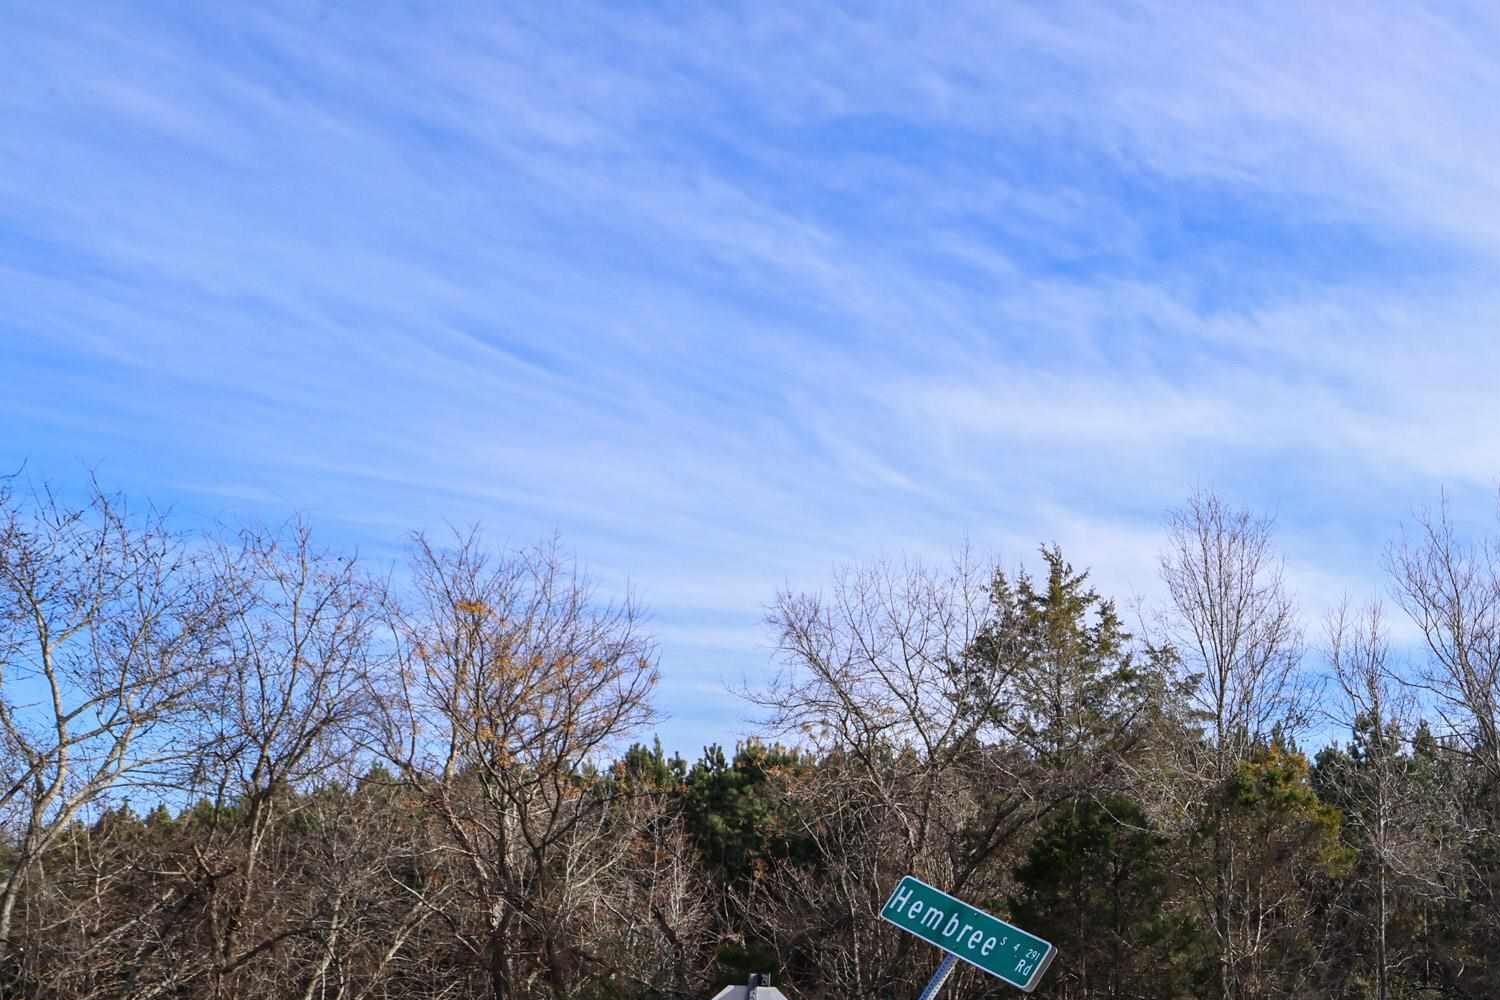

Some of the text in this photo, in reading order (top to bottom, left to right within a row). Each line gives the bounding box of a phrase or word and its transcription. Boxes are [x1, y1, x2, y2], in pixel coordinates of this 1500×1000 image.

[889, 885, 997, 956] Hembree
[1025, 948, 1040, 961] 291
[1014, 959, 1033, 977] Rd
